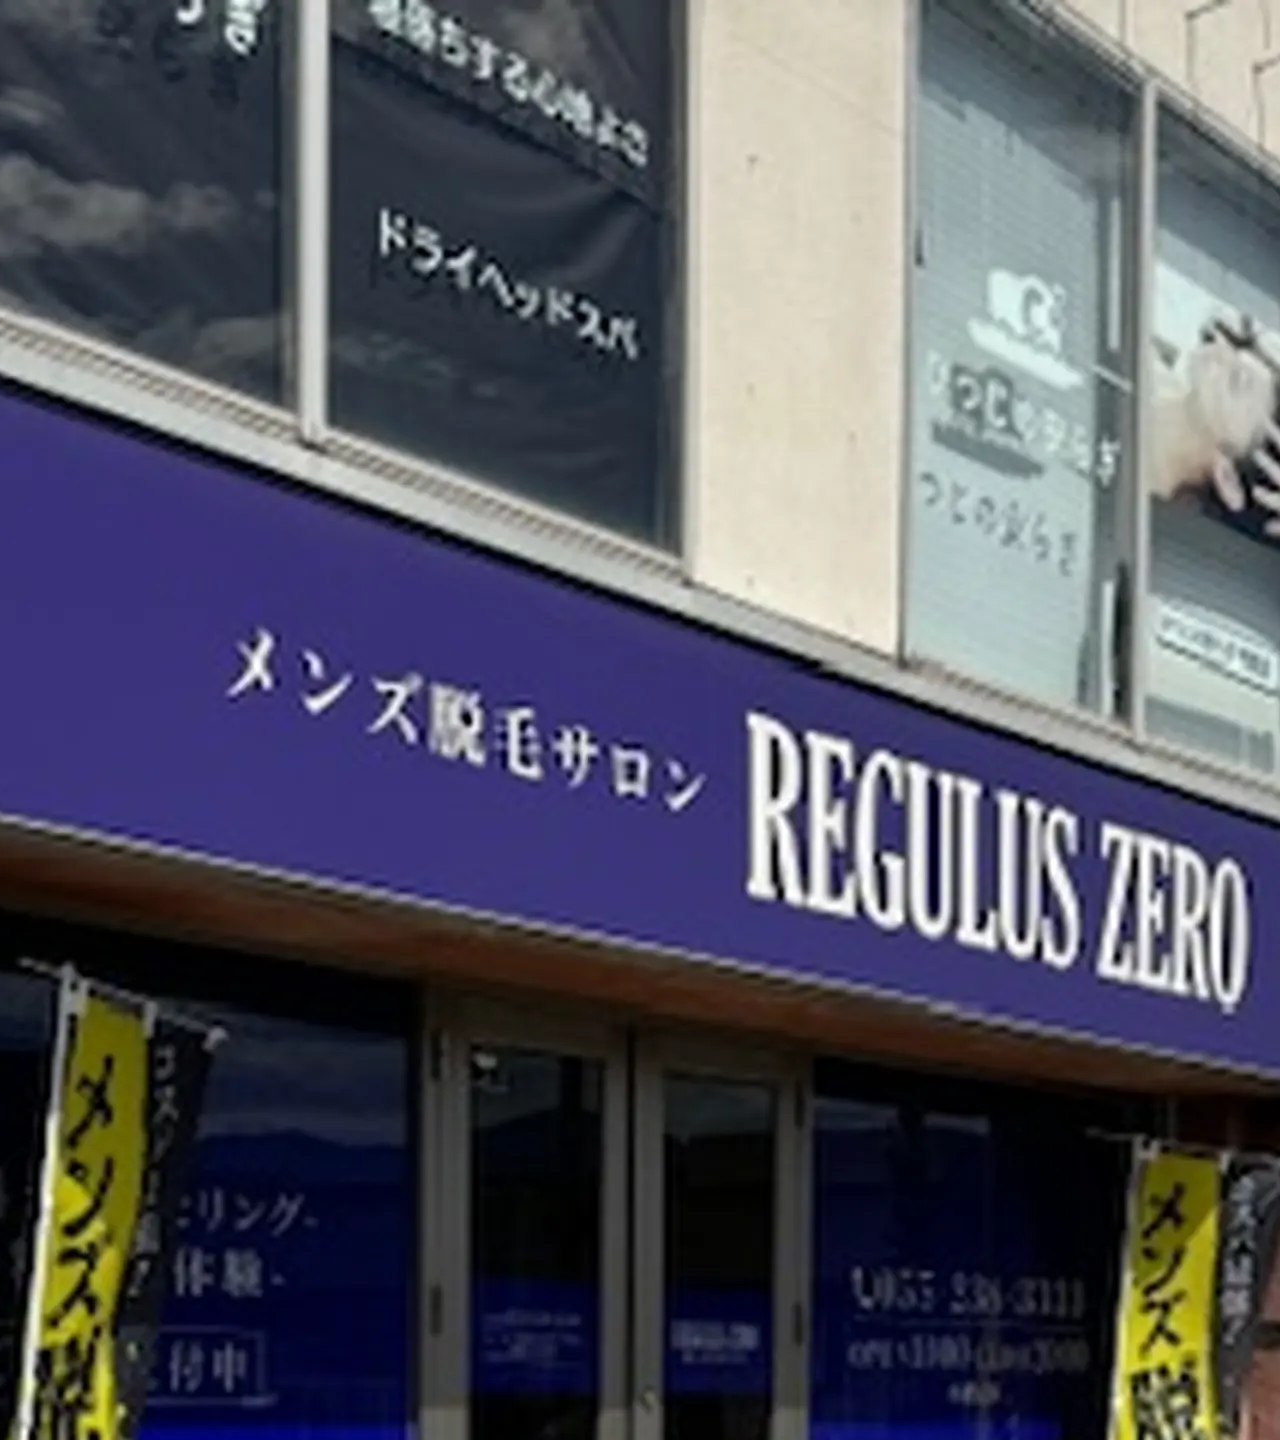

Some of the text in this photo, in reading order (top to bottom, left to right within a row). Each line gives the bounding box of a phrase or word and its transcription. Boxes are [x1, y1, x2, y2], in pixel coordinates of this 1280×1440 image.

[378, 207, 639, 360] ドライヘッドスパ
[226, 627, 706, 812] メンズ脱毛サロン
[746, 710, 1250, 1010] REGULUS ZERO
